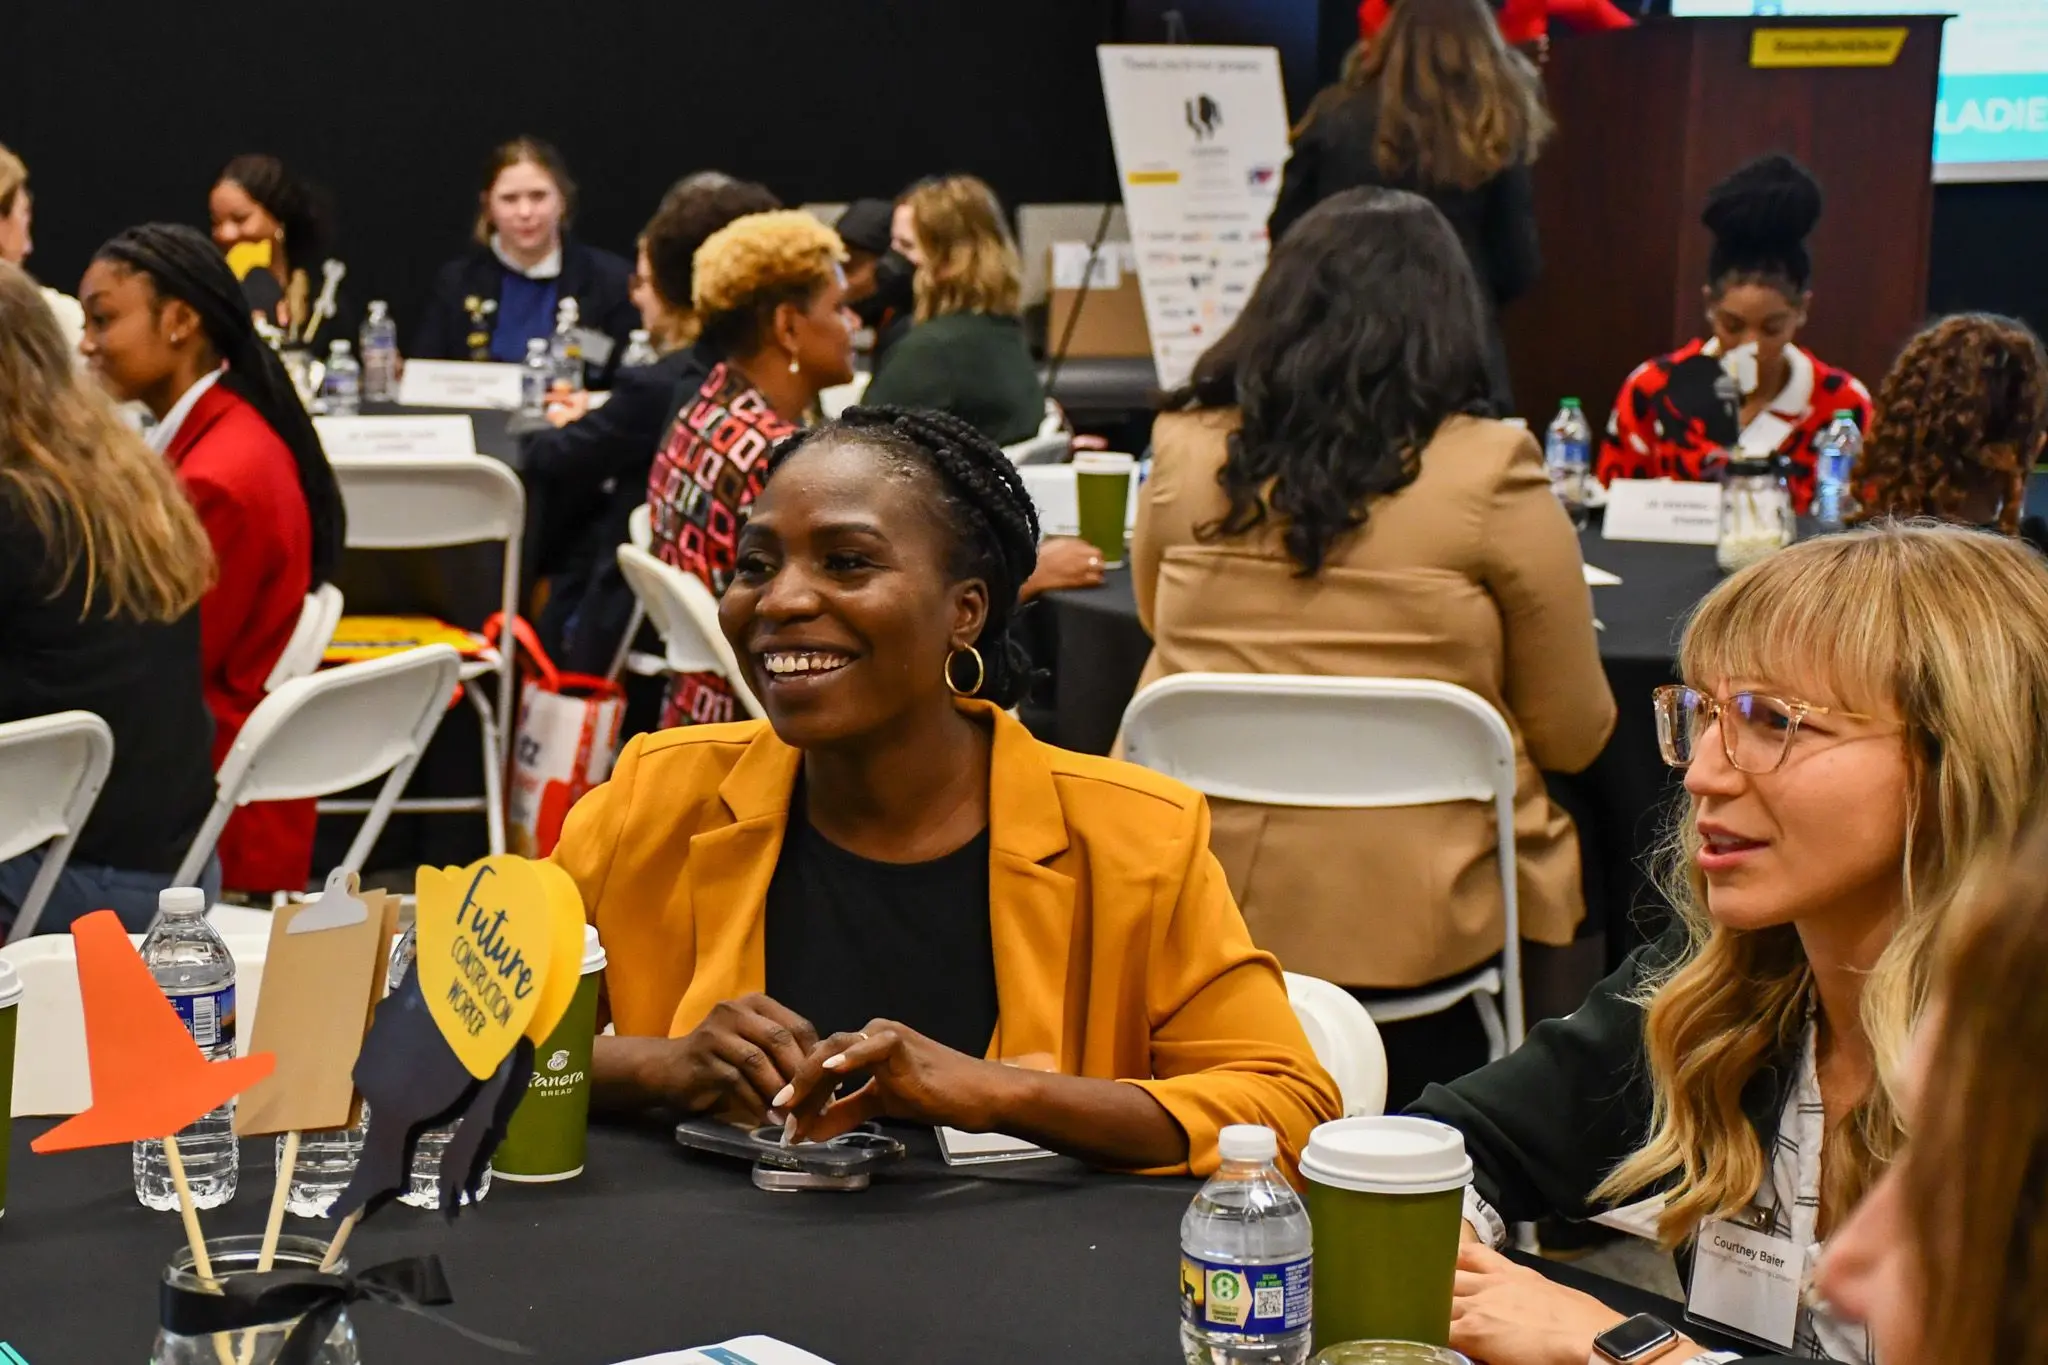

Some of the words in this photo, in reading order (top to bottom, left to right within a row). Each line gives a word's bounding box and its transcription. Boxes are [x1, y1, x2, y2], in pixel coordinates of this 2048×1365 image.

[456, 864, 533, 1000] Future
[450, 935, 514, 1028] CONSTRUCTION
[446, 977, 487, 1037] WORKER
[528, 1071, 584, 1088] Panera
[540, 1088, 572, 1097] BREAD
[1713, 1235, 1758, 1261] Courtney
[1759, 1250, 1785, 1268] Baier
